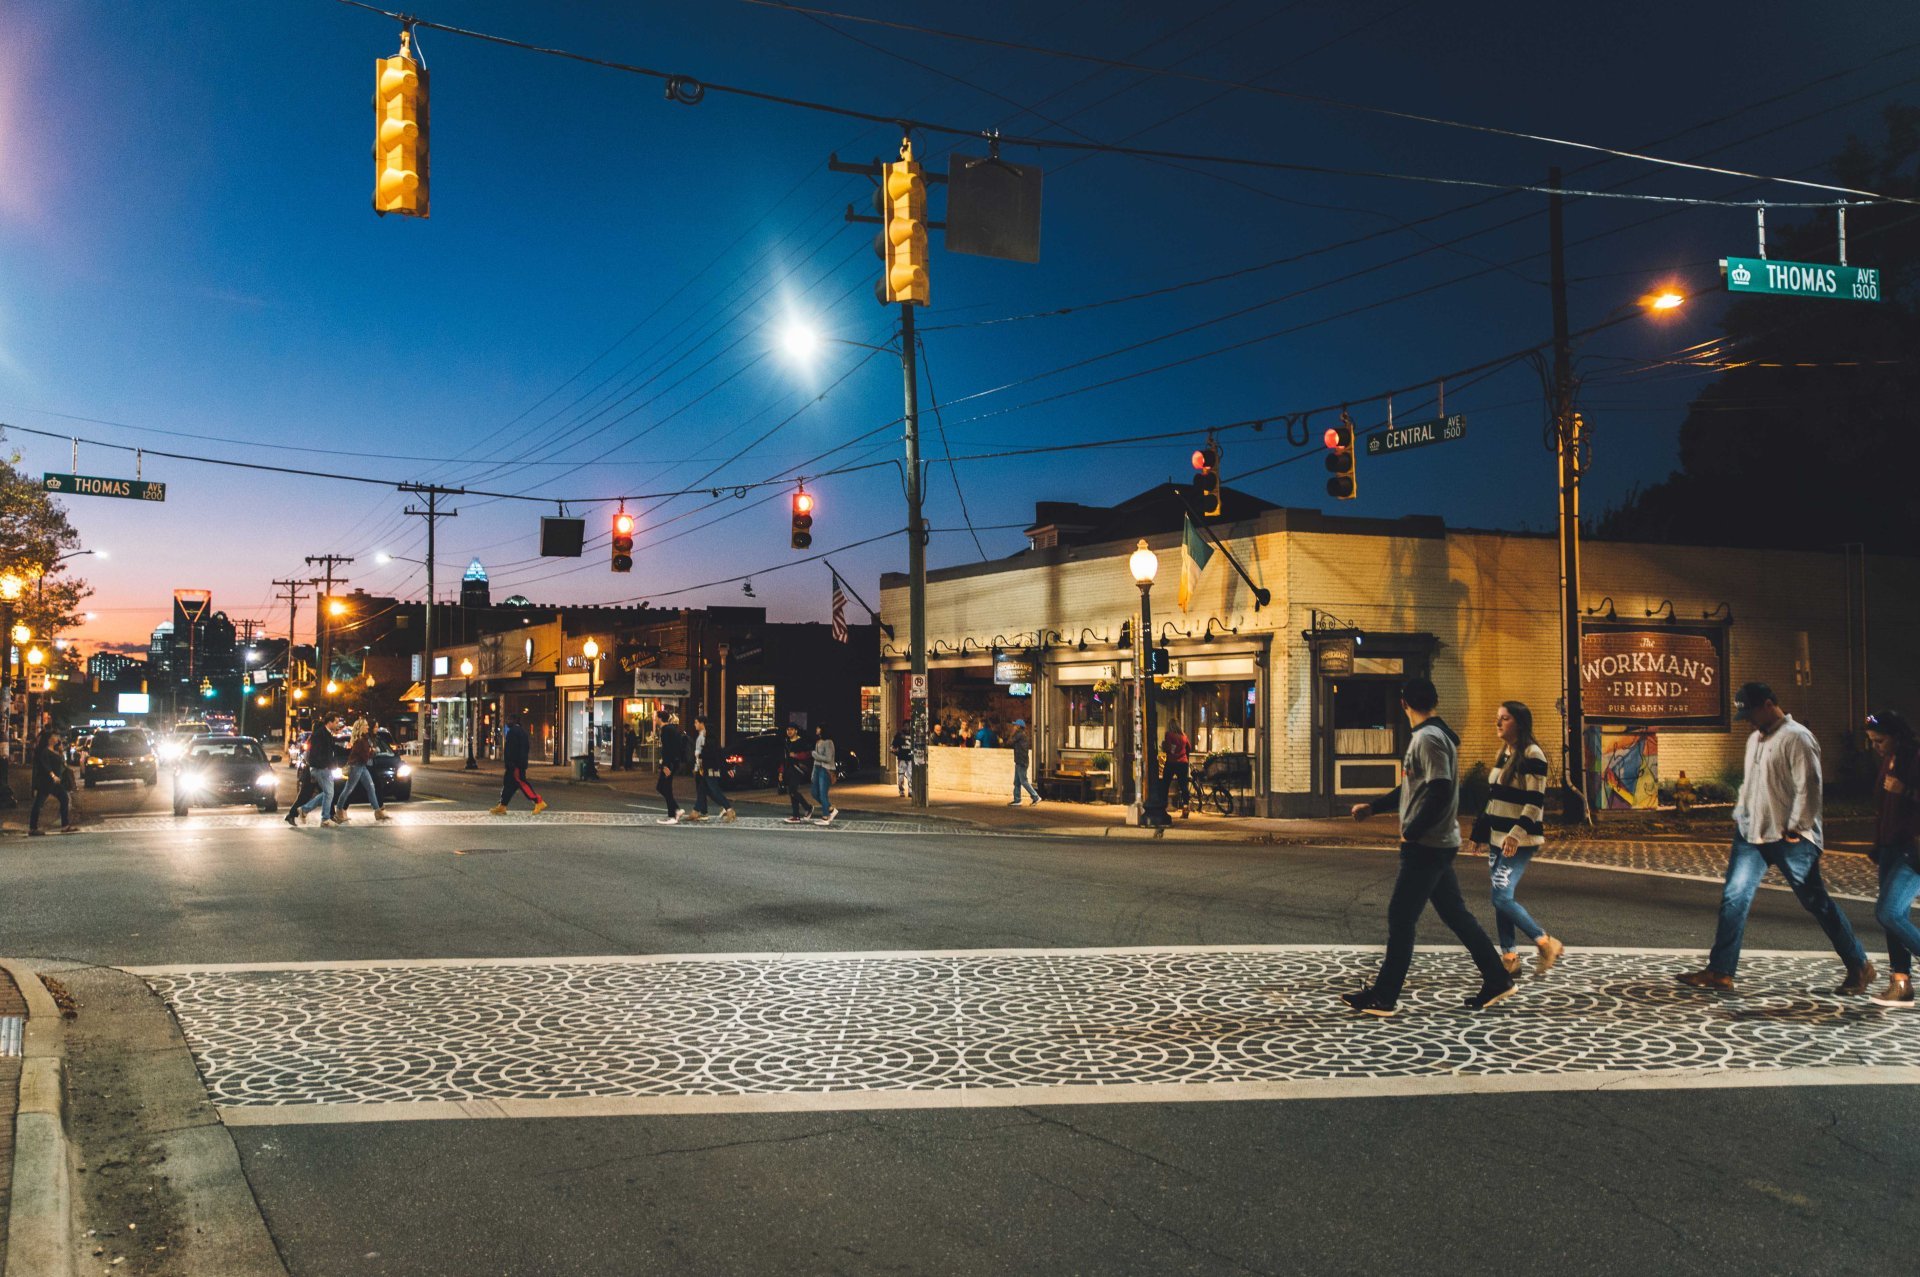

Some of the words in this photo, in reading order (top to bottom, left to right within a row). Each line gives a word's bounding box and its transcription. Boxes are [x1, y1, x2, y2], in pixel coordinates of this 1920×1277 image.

[1766, 264, 1837, 293] THOMAS
[1857, 268, 1876, 284] AVE
[1853, 284, 1877, 300] 1300
[1448, 415, 1461, 427] AVE
[1387, 424, 1435, 448] CENTRAL
[1444, 427, 1461, 439] 1500
[74, 478, 130, 496] THOMAS
[147, 482, 163, 491] AVE
[142, 490, 163, 500] 1200
[1640, 637, 1655, 648] The
[1582, 652, 1714, 686] WORKMAN'S
[651, 671, 673, 687] High
[674, 672, 690, 682] Life
[1613, 681, 1682, 697] FRIEND
